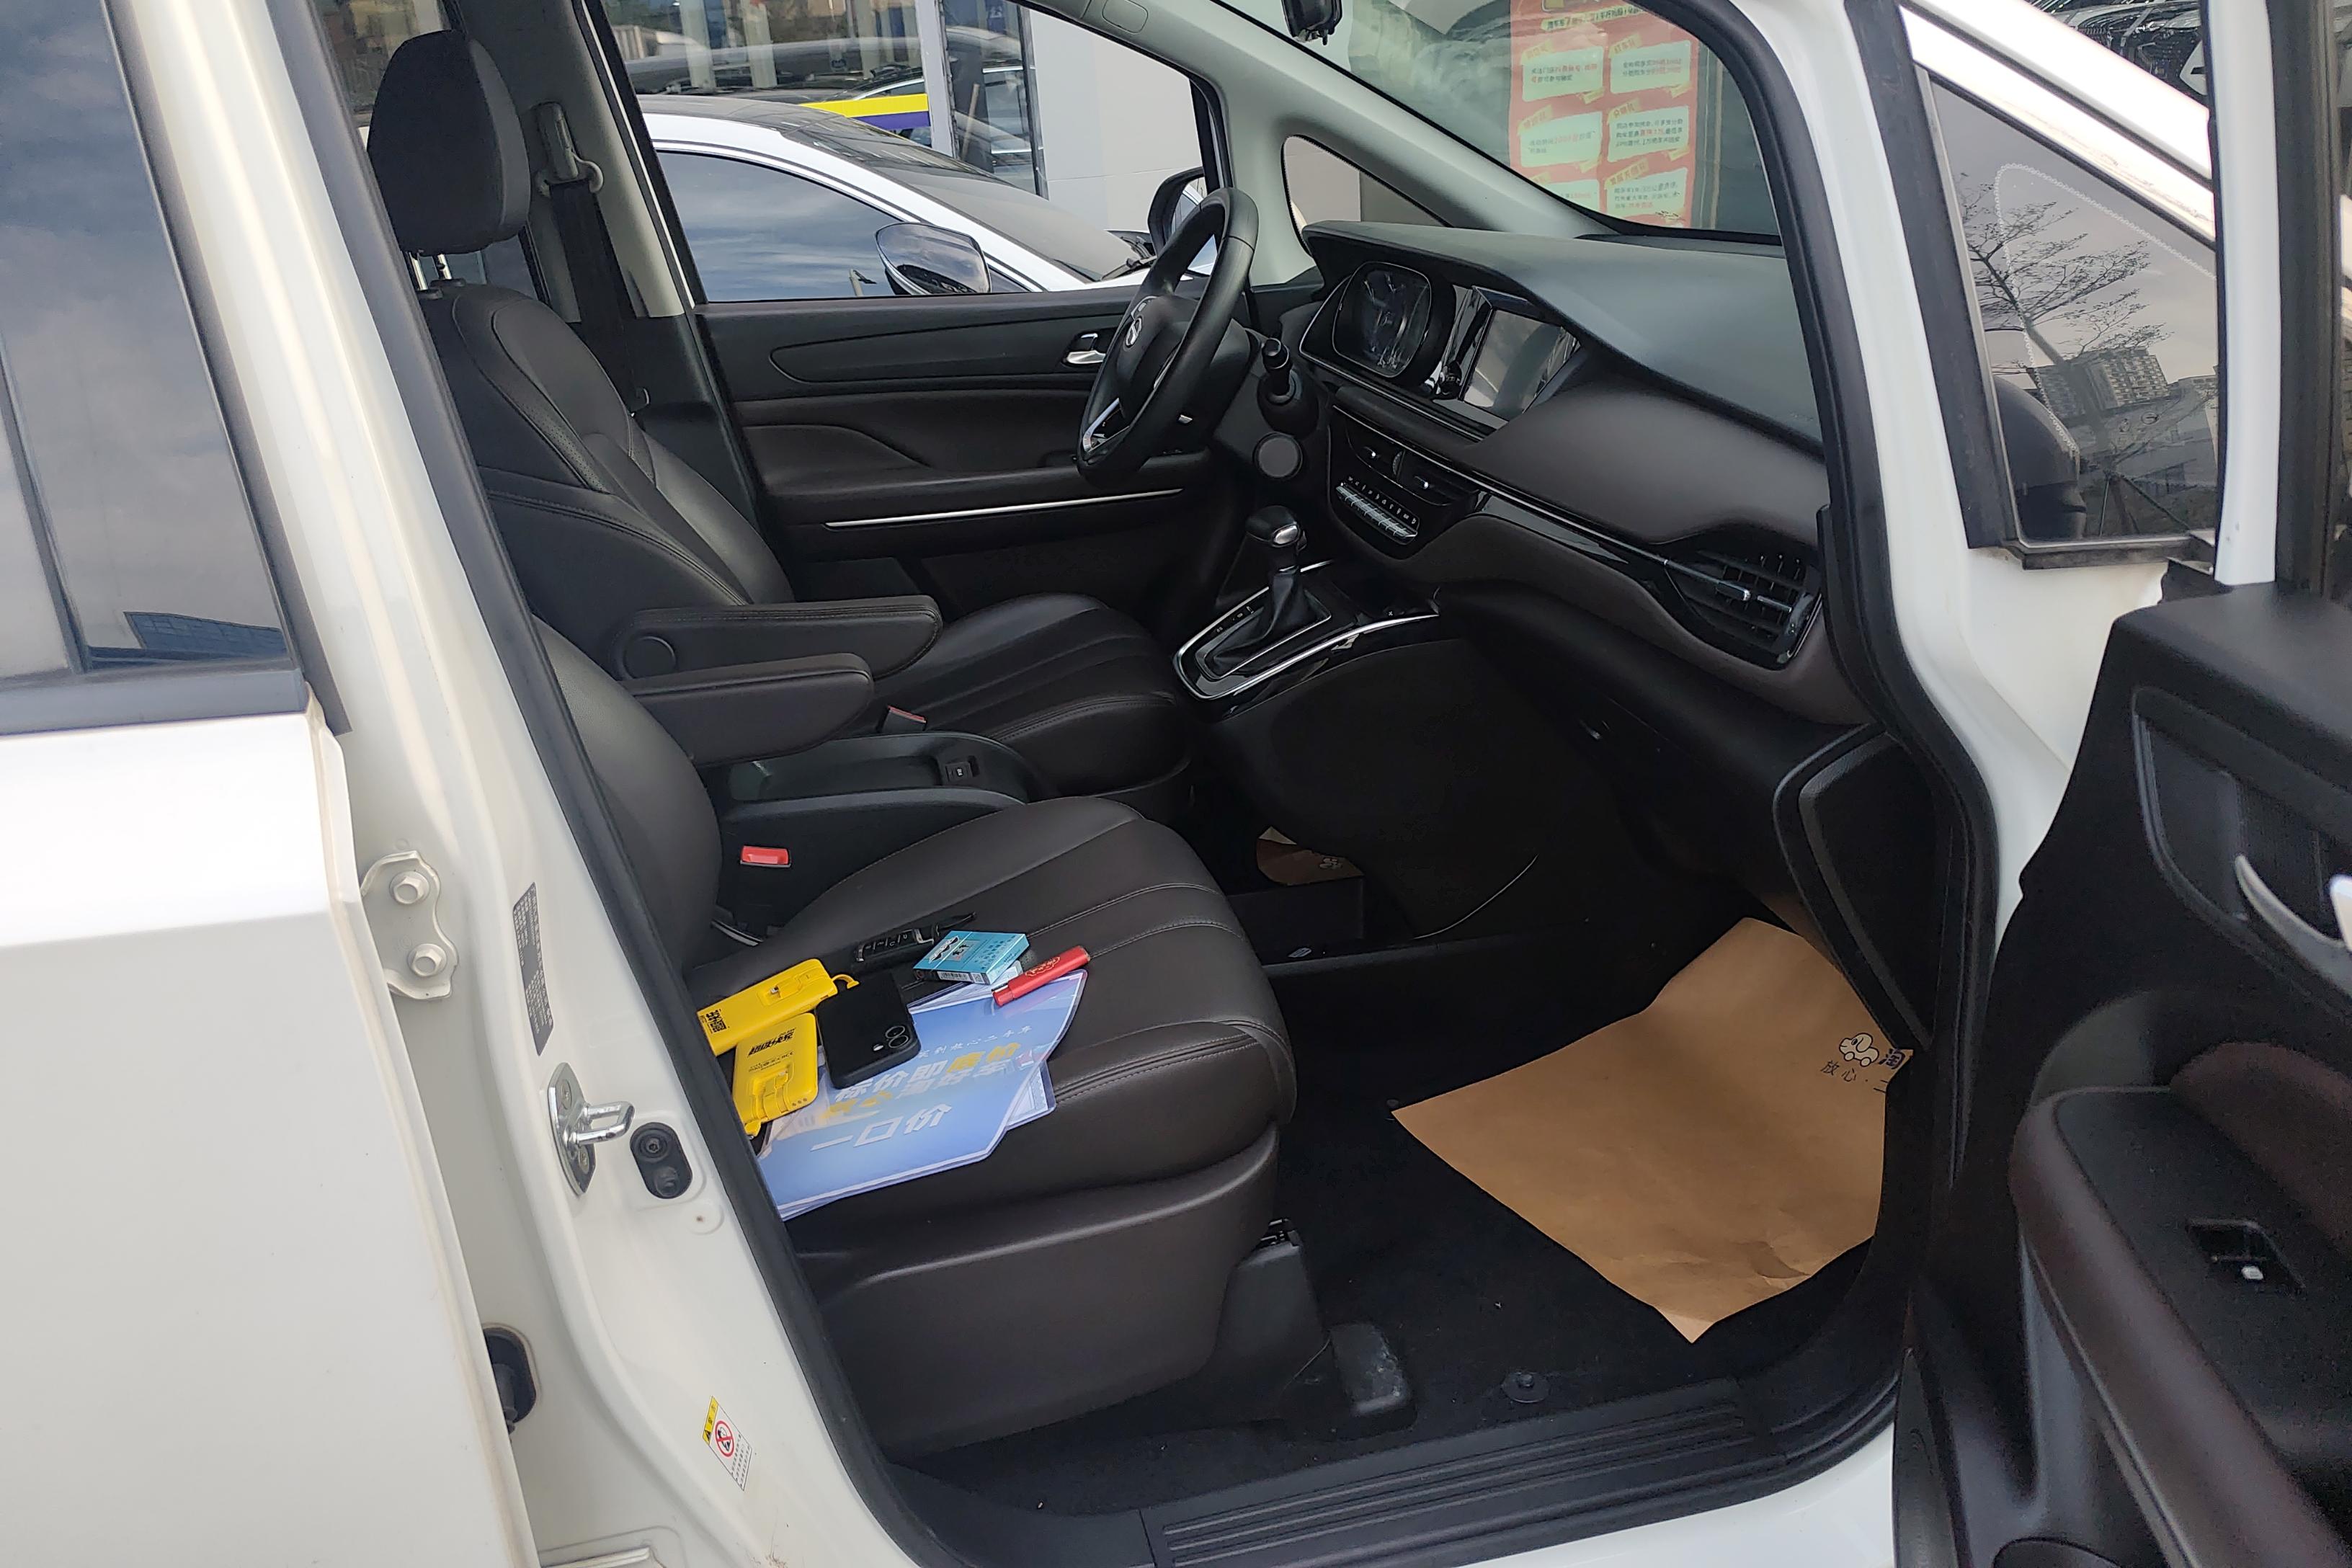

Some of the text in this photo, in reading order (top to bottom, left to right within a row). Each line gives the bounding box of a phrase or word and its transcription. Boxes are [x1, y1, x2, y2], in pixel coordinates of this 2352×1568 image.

[834, 1042, 1021, 1102] 标价即底价
[810, 1103, 953, 1152] 一口价
